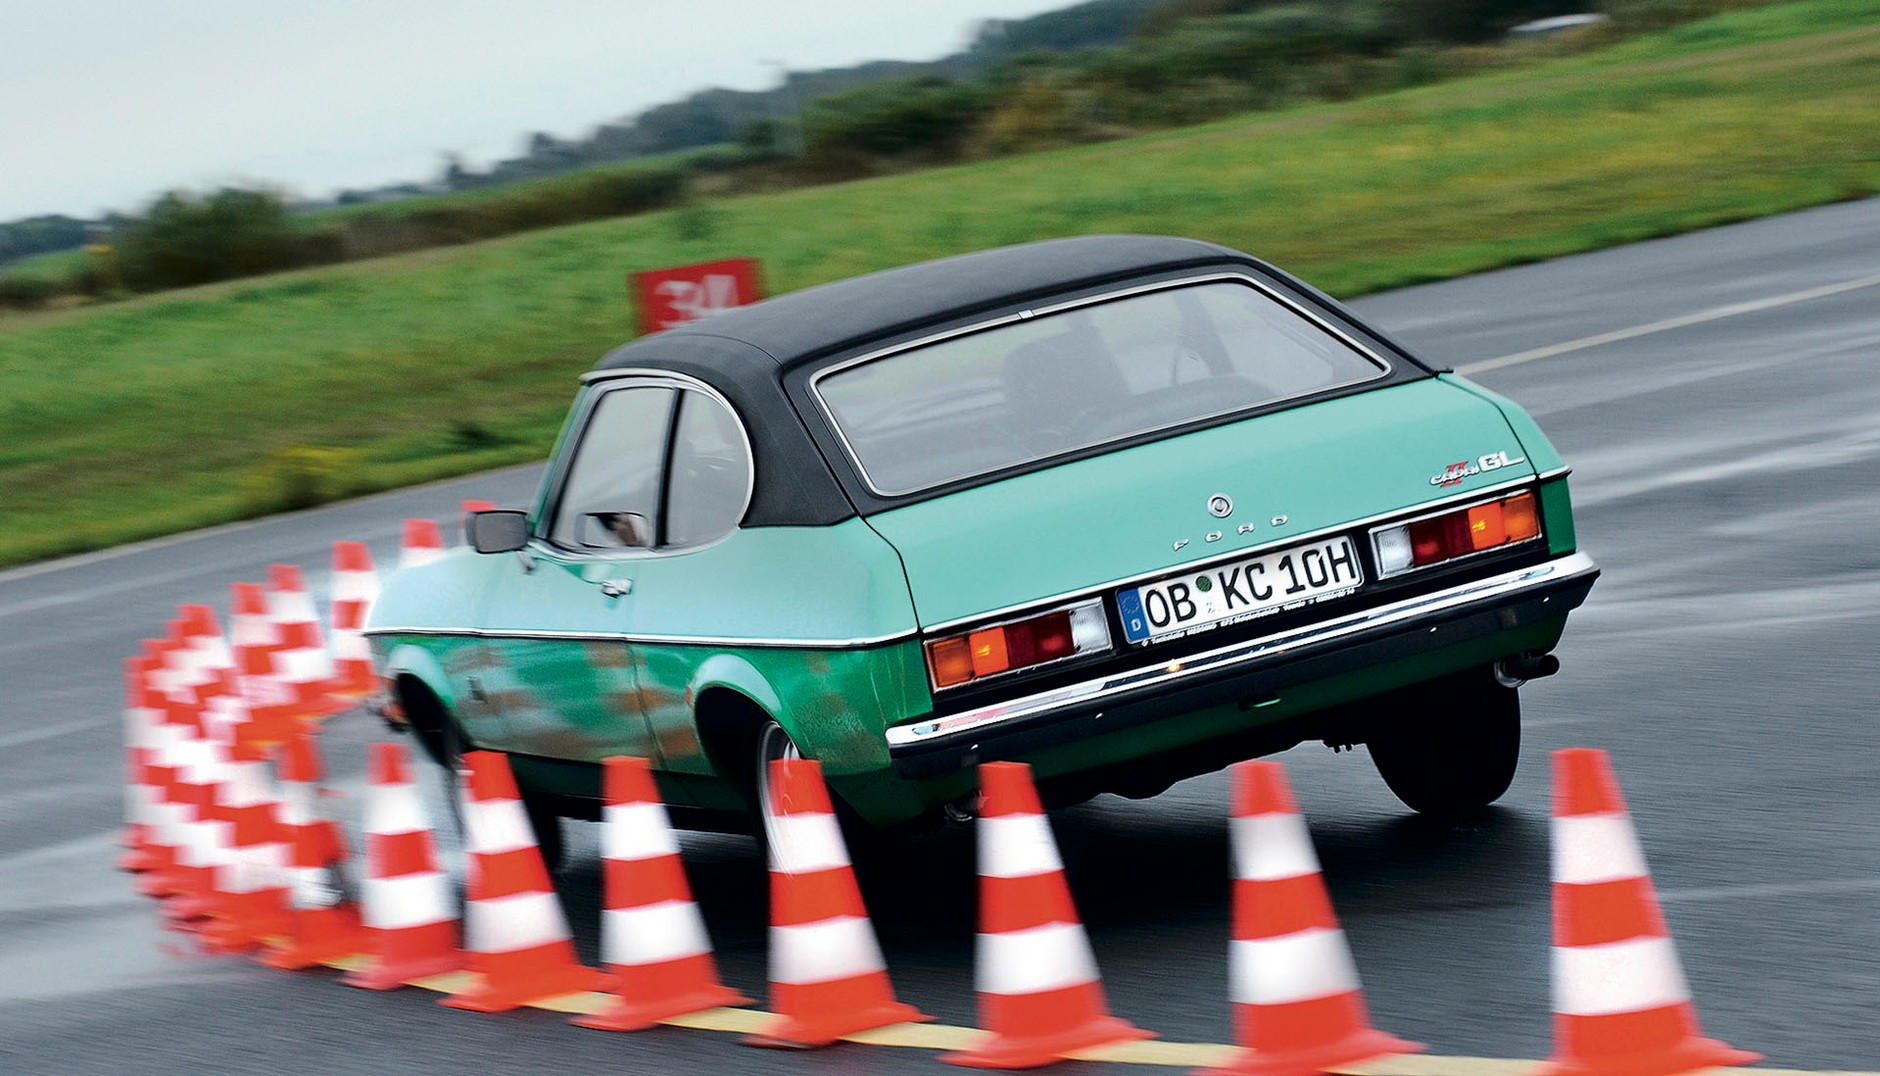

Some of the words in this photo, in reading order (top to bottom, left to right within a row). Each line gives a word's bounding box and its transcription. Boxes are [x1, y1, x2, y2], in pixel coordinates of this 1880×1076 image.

[1478, 450, 1525, 473] GL
[1172, 514, 1289, 552] FORD
[1145, 582, 1197, 628] OB
[1218, 563, 1273, 610] KC
[1278, 541, 1357, 595] 10H
[1131, 618, 1142, 632] D
